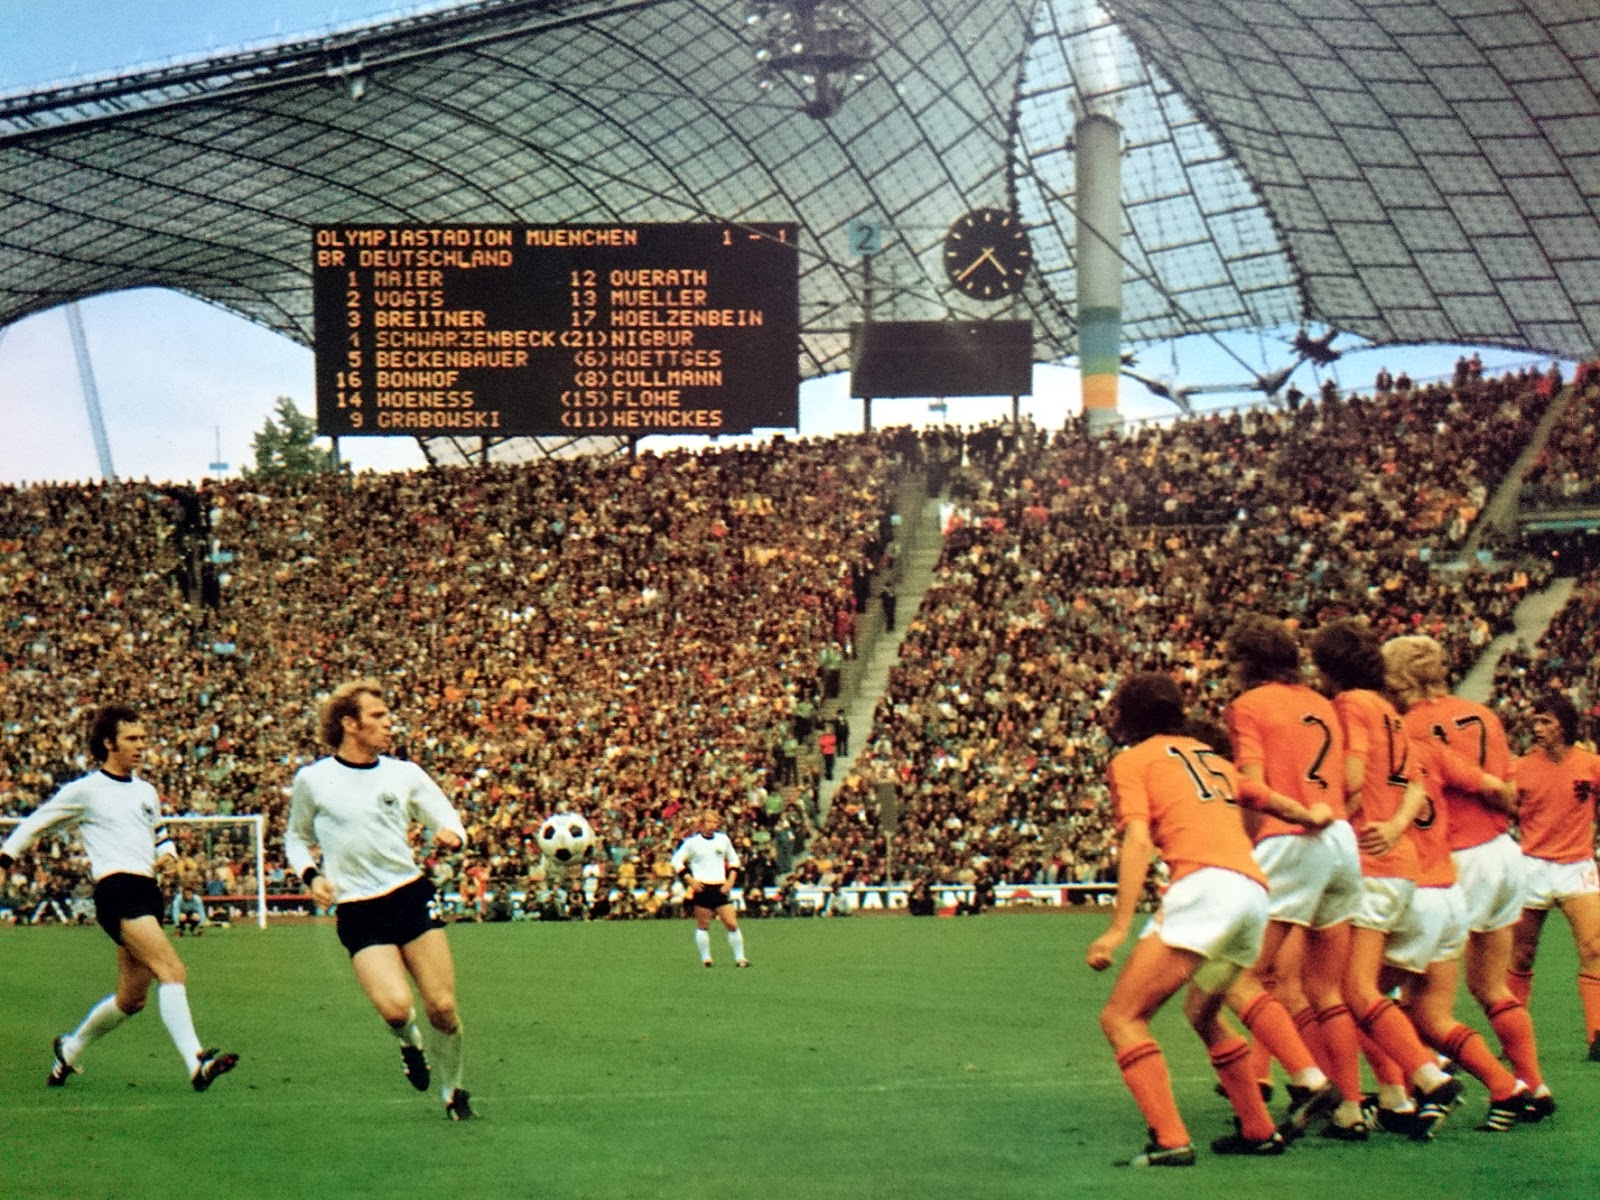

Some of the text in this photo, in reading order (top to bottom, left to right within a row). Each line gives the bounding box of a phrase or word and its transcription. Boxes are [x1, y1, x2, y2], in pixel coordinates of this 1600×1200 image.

[316, 228, 638, 247] OLYMPIASTADION MUENCHEN
[722, 229, 733, 246] 1
[778, 228, 787, 243] 1
[856, 224, 874, 251] 2
[317, 249, 513, 269] BR DEUTSCHLAND
[348, 269, 443, 288] 1 MAIER
[571, 268, 708, 287] 12 OVERATH
[346, 290, 444, 308] 2 VOGTS
[571, 288, 708, 307] 13 MUELLER
[347, 310, 486, 328] 3 BREITNER
[571, 308, 763, 328] 17 HOELZENBEIN
[375, 330, 556, 348] SCHWARZENBECK
[610, 329, 695, 347] NIGBUR
[348, 350, 529, 369] 5 BECKENBAUER
[610, 349, 722, 368] HOETTGES
[336, 370, 460, 389] 16 BONHOF
[611, 369, 723, 388] CULLMANN
[337, 390, 474, 409] 14 HOENESS
[612, 389, 682, 408] FLOHE
[349, 410, 500, 428] 9 GRABOWSKI
[612, 409, 723, 428] HEYNCKES
[1301, 714, 1332, 790] 2
[1166, 745, 1238, 807] 15
